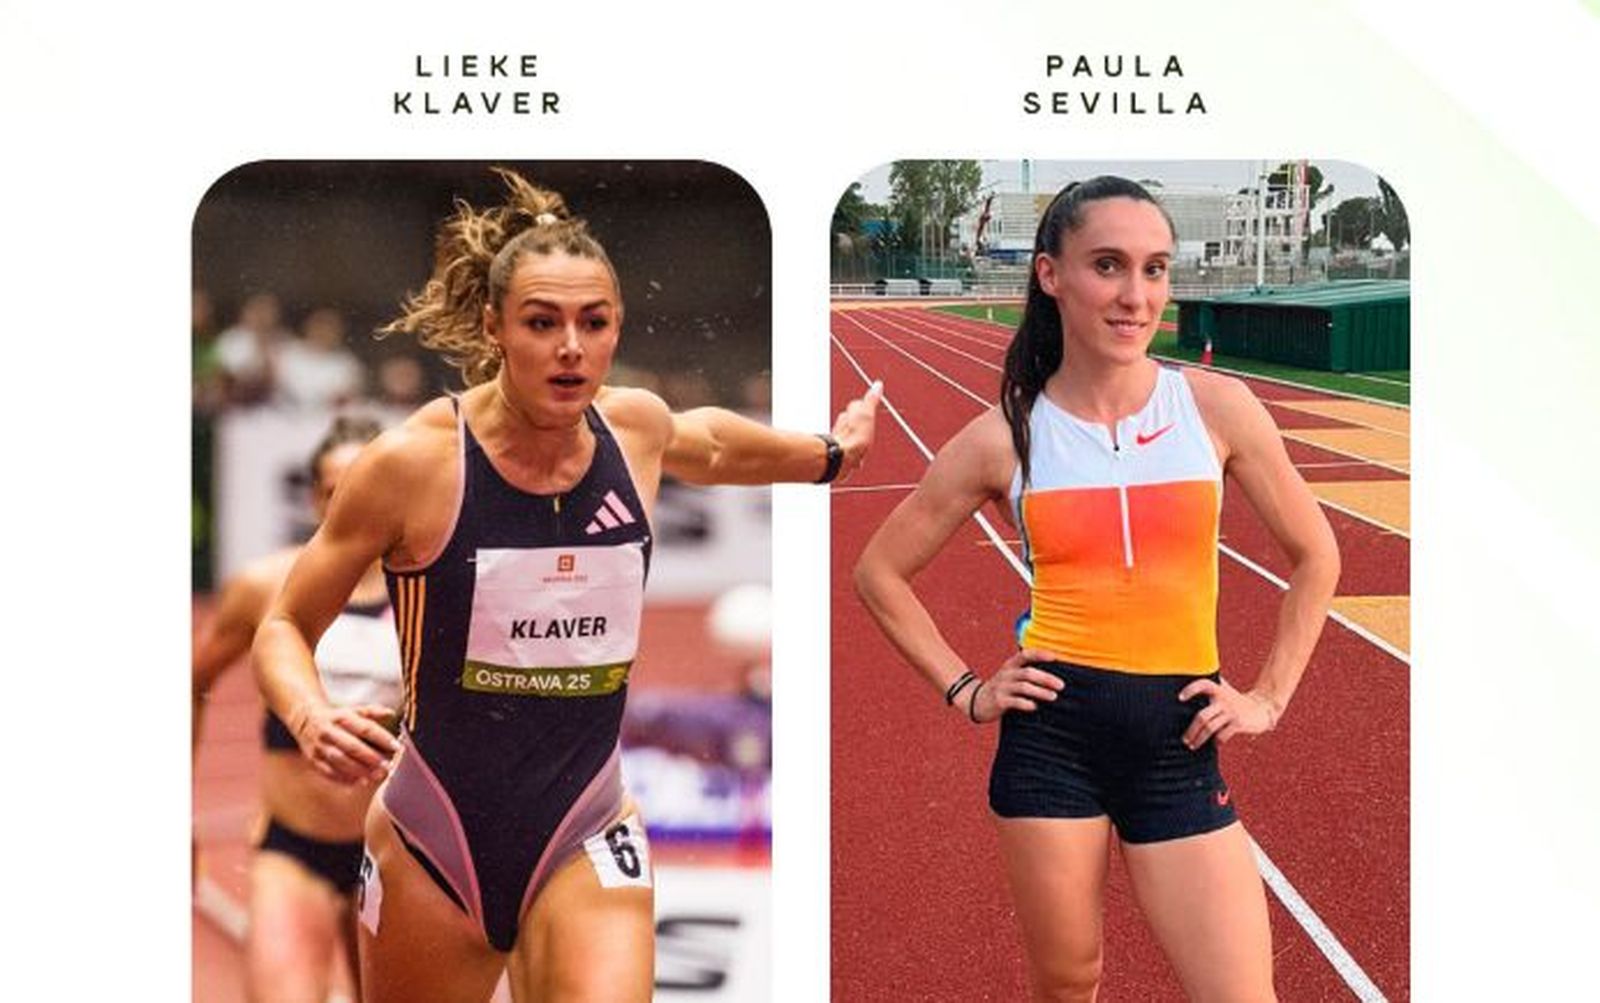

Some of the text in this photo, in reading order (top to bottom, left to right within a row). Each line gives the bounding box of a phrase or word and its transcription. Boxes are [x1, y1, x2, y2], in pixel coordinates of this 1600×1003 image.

[510, 616, 608, 640] KLAVER
[475, 668, 592, 691] OSTRAVA 25
[604, 823, 642, 879] 6
